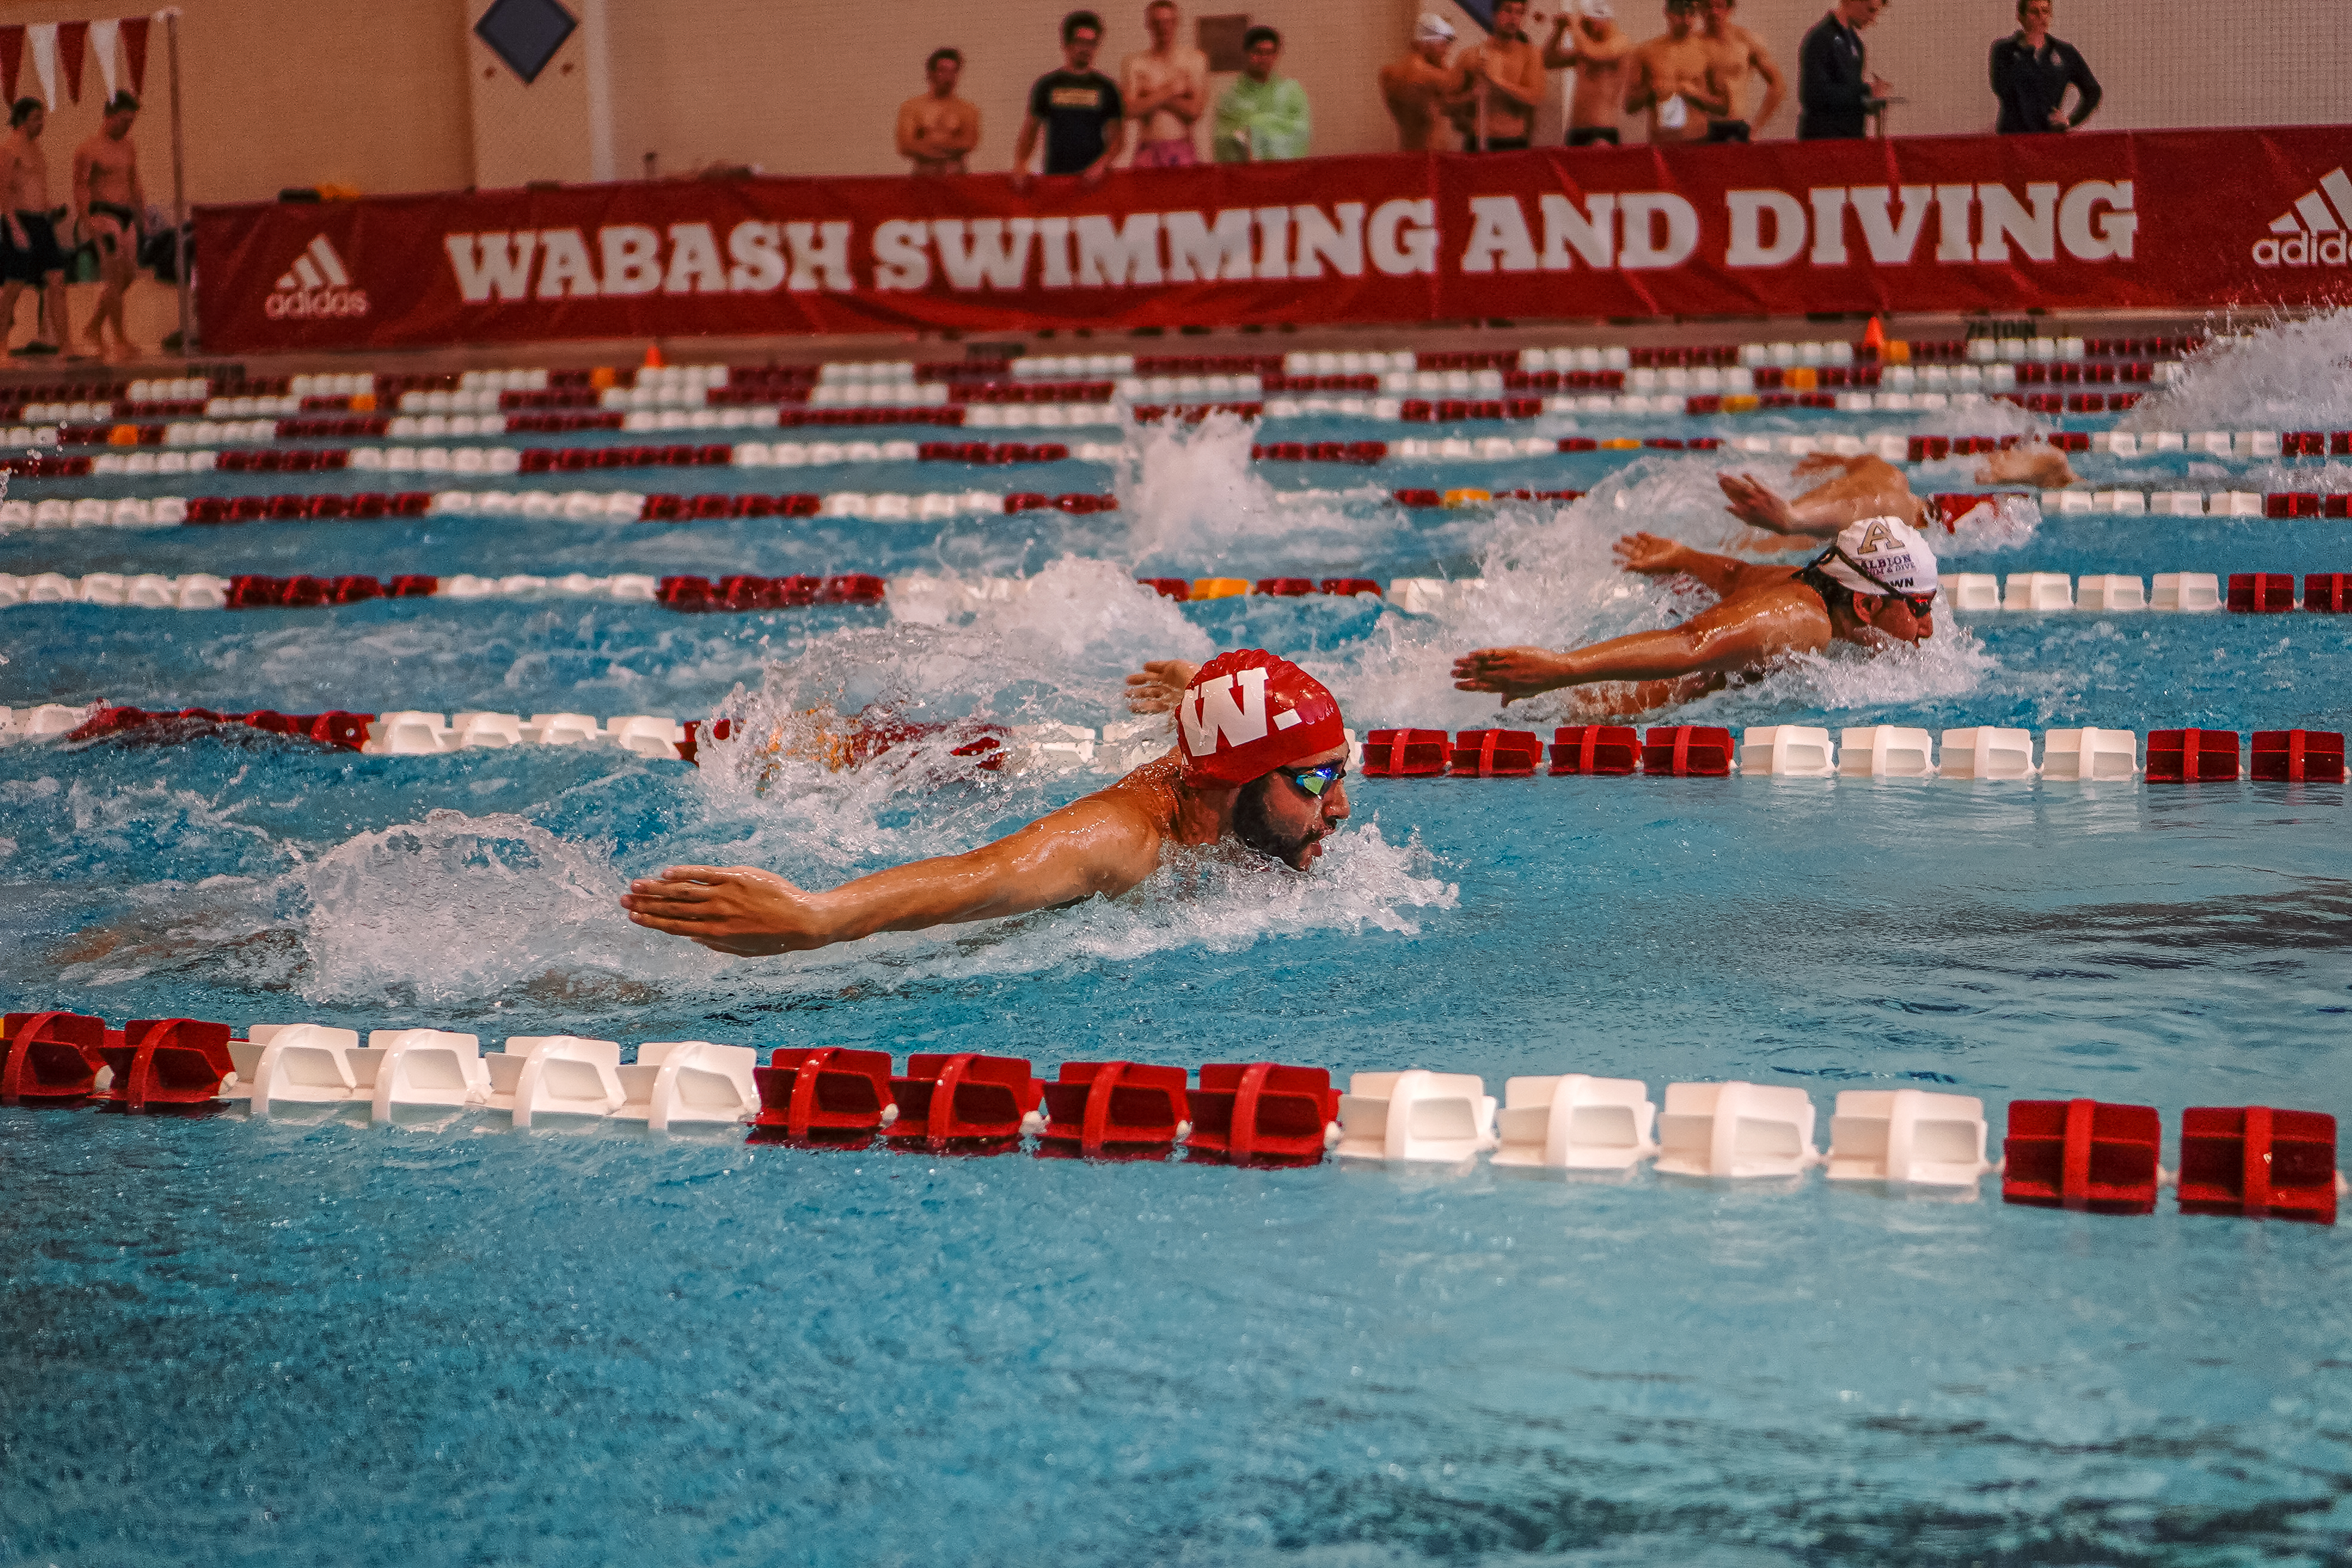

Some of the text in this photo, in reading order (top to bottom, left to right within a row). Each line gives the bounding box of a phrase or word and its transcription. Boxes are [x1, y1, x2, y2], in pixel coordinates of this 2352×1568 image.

[445, 180, 2136, 301] WABASH SWIMMING AND DIVING
[2252, 229, 2352, 267] adid
[265, 290, 370, 319] adidas
[1857, 520, 1905, 555] A
[1860, 553, 1912, 569] ALBION
[1895, 562, 1916, 572] DIVE
